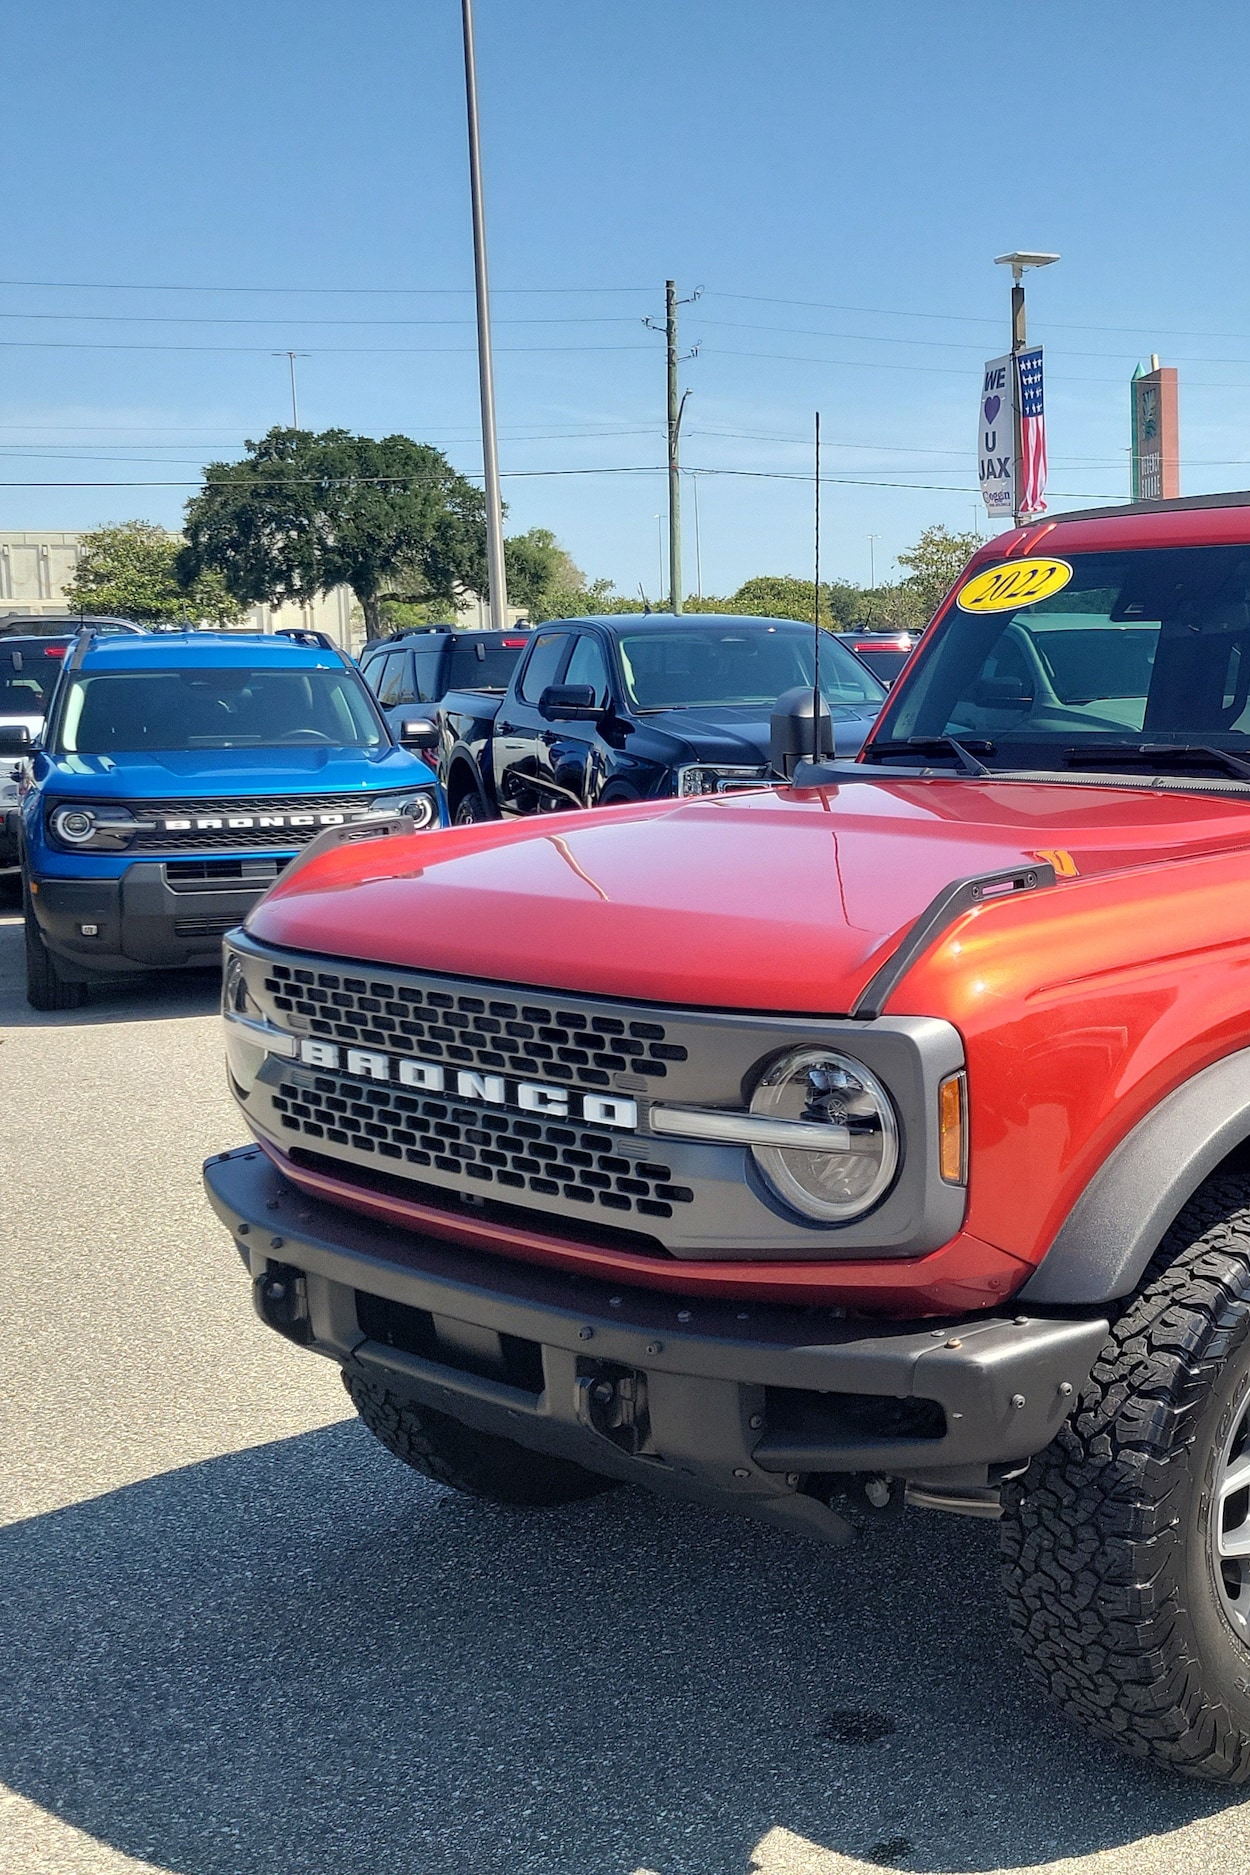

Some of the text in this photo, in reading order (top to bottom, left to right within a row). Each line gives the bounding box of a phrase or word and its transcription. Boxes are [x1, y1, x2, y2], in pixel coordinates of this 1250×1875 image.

[984, 367, 1006, 391] WE
[985, 431, 996, 452] U
[979, 457, 1011, 481] JAX
[969, 567, 1056, 604] 2022
[165, 814, 344, 831] BRONCO
[301, 1038, 637, 1129] BRONCO
